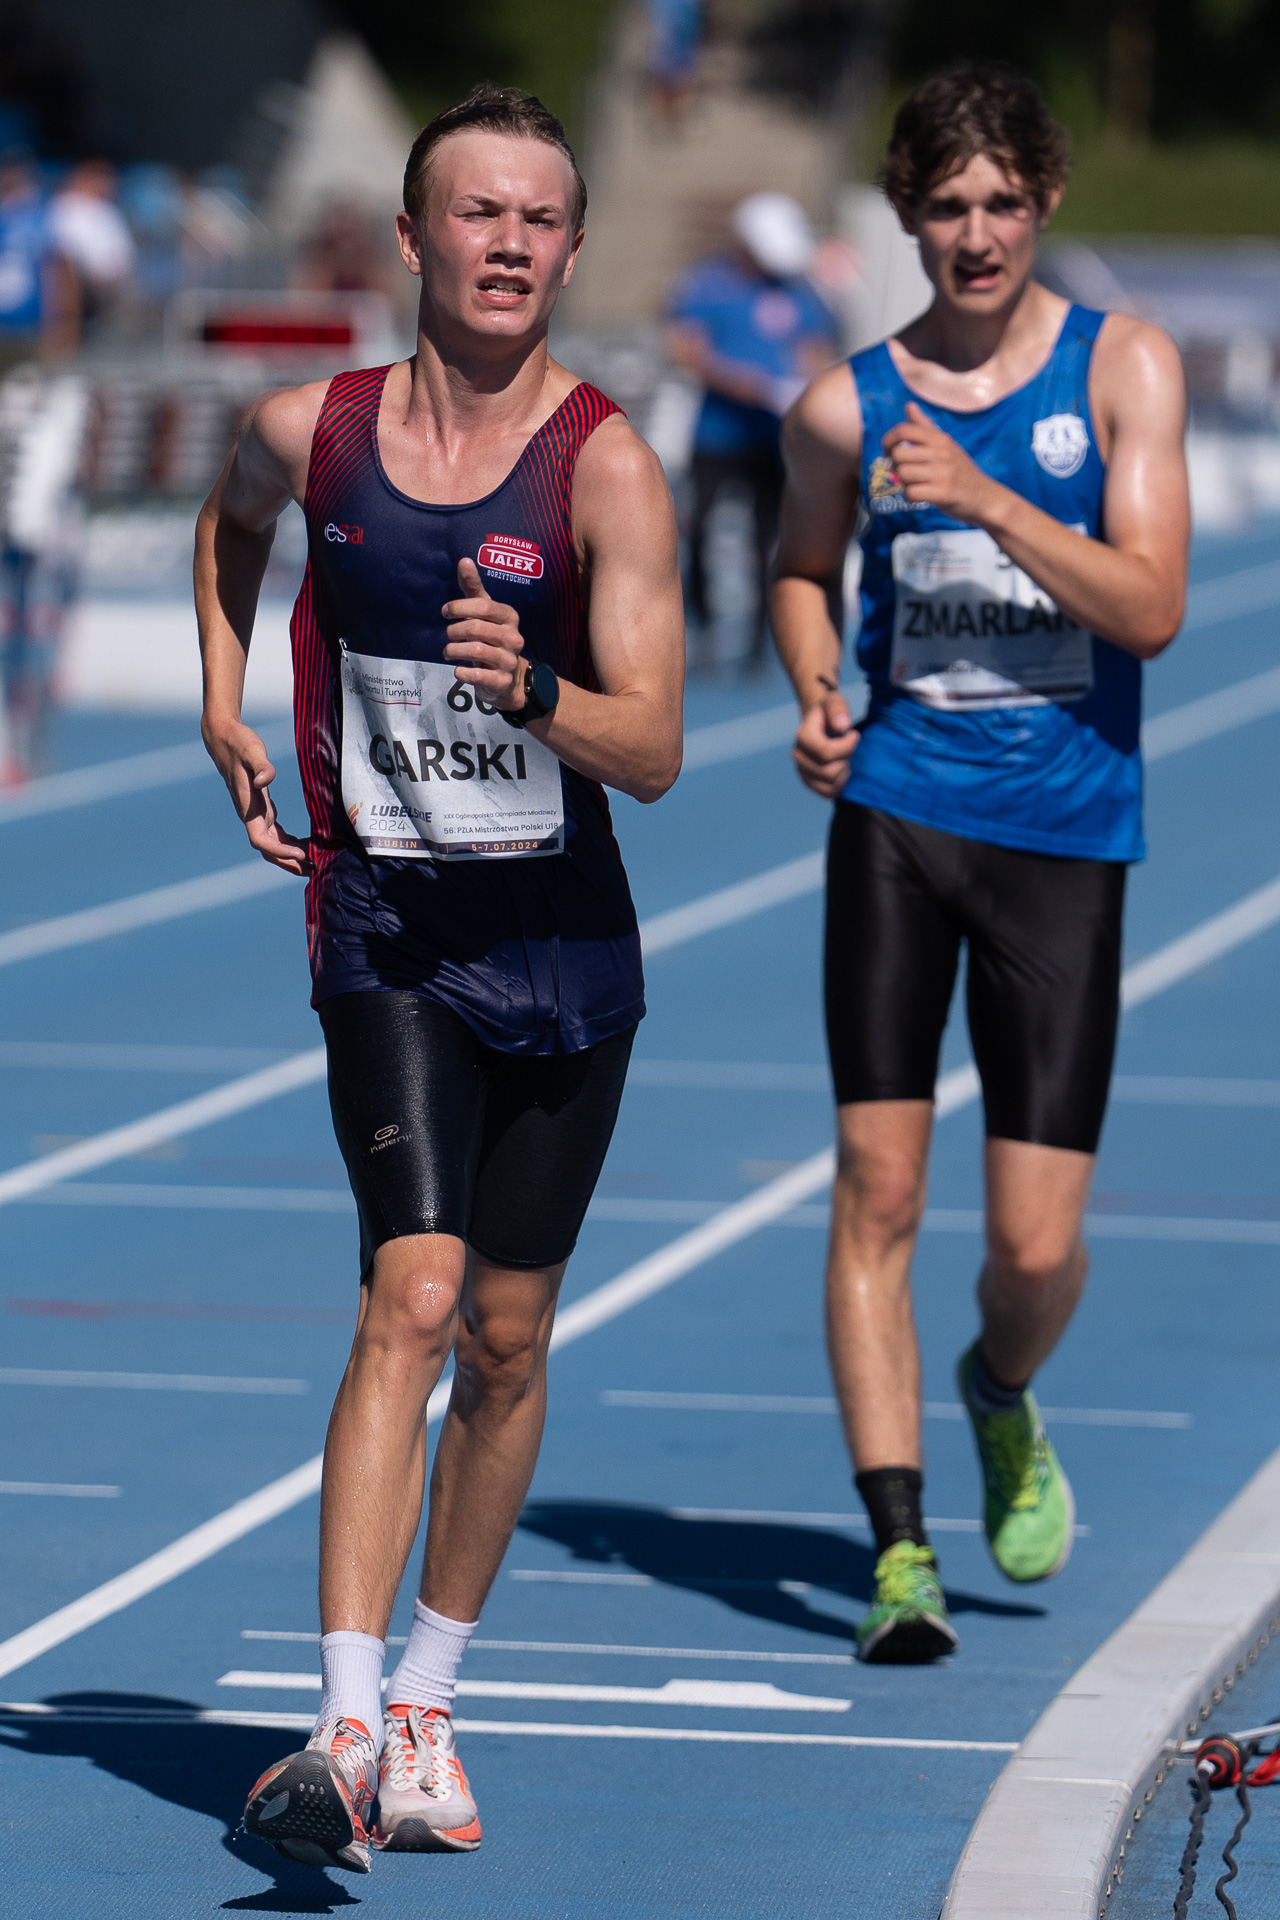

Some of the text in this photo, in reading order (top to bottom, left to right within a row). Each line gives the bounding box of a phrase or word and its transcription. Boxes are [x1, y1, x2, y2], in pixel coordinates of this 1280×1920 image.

[493, 535, 533, 550] BORYSŁAW
[486, 548, 537, 573] TALEX
[384, 687, 422, 698] Turystyki
[369, 733, 527, 783] GARSKI
[370, 804, 433, 823] LUBELSKIE
[369, 818, 407, 832] 2024
[457, 826, 474, 834] PZLA
[474, 824, 519, 834] Mistrzostwa
[520, 823, 544, 832] Polski
[544, 822, 559, 831] U18
[378, 839, 418, 849] LUBLIN
[471, 840, 539, 852] 5-7.07.2024
